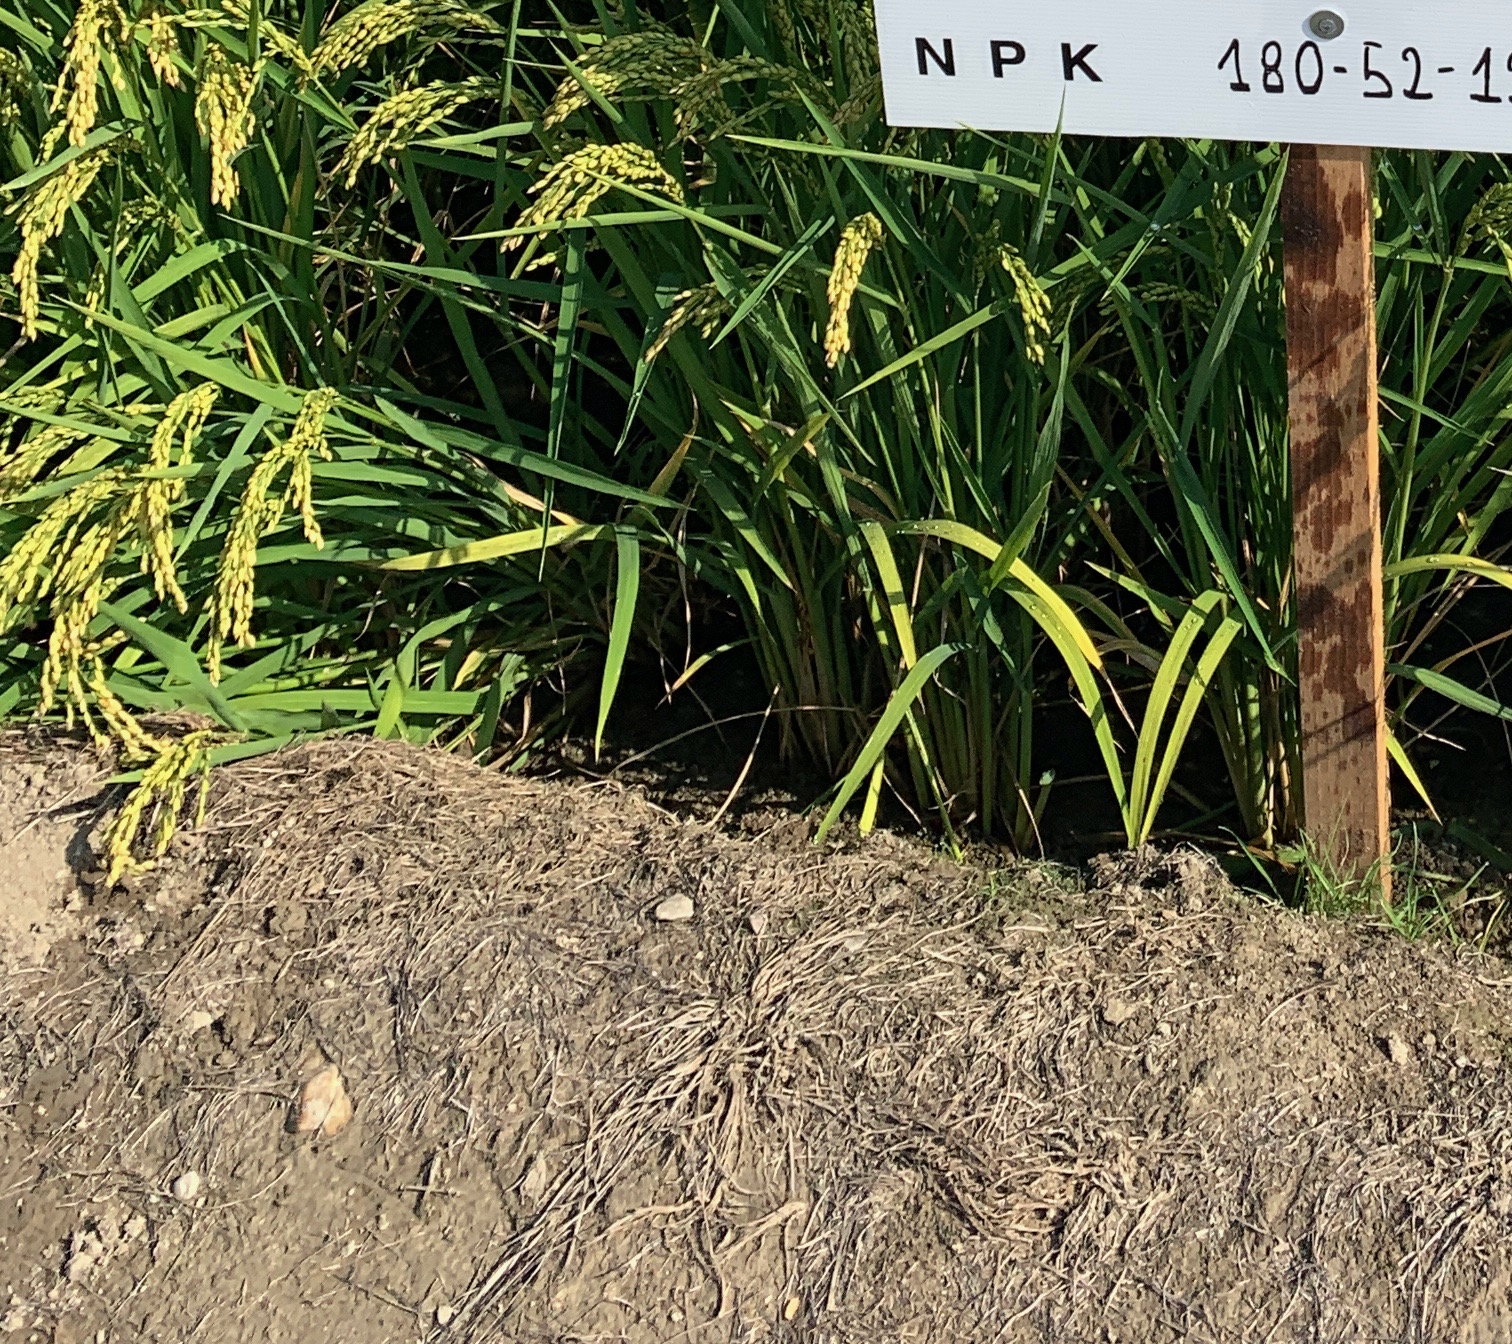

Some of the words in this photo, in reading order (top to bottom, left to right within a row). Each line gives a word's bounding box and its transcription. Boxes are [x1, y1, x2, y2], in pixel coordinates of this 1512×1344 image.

[915, 37, 956, 77] N
[989, 39, 1026, 79] P
[1060, 42, 1102, 83] K
